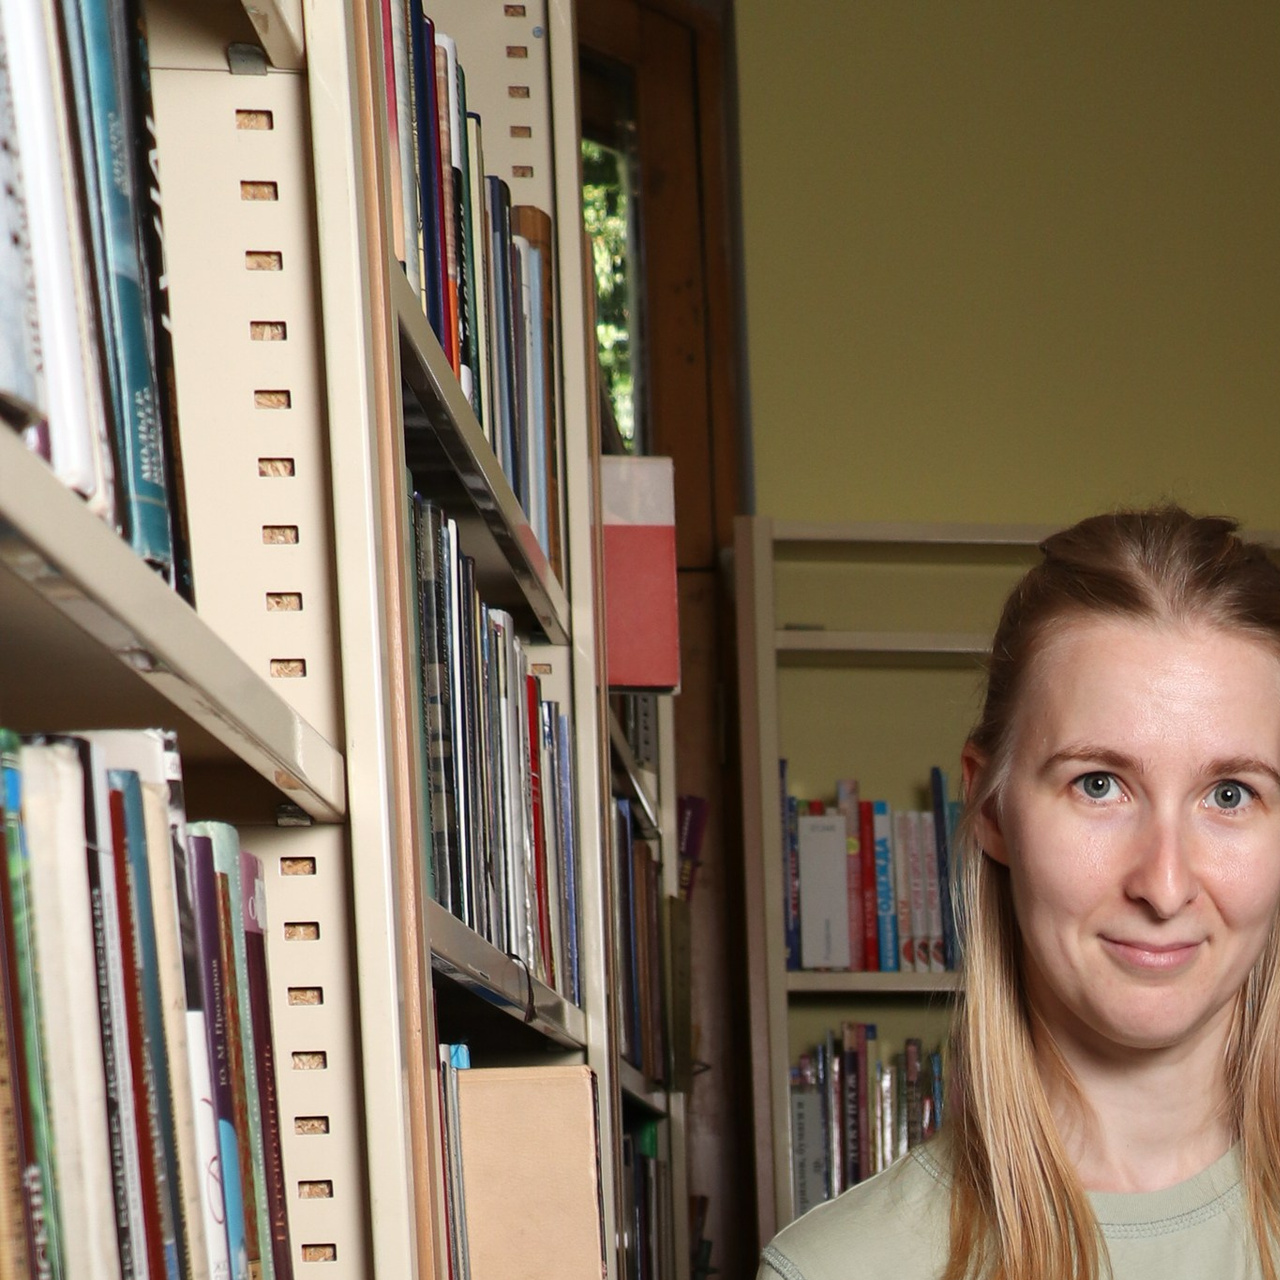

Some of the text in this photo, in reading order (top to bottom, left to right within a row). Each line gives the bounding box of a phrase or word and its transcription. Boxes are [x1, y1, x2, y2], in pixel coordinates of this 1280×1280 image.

[89, 886, 125, 1101] ДОСТОЕВСКИЙ
[210, 958, 228, 1087] Ю. М. Прозоров
